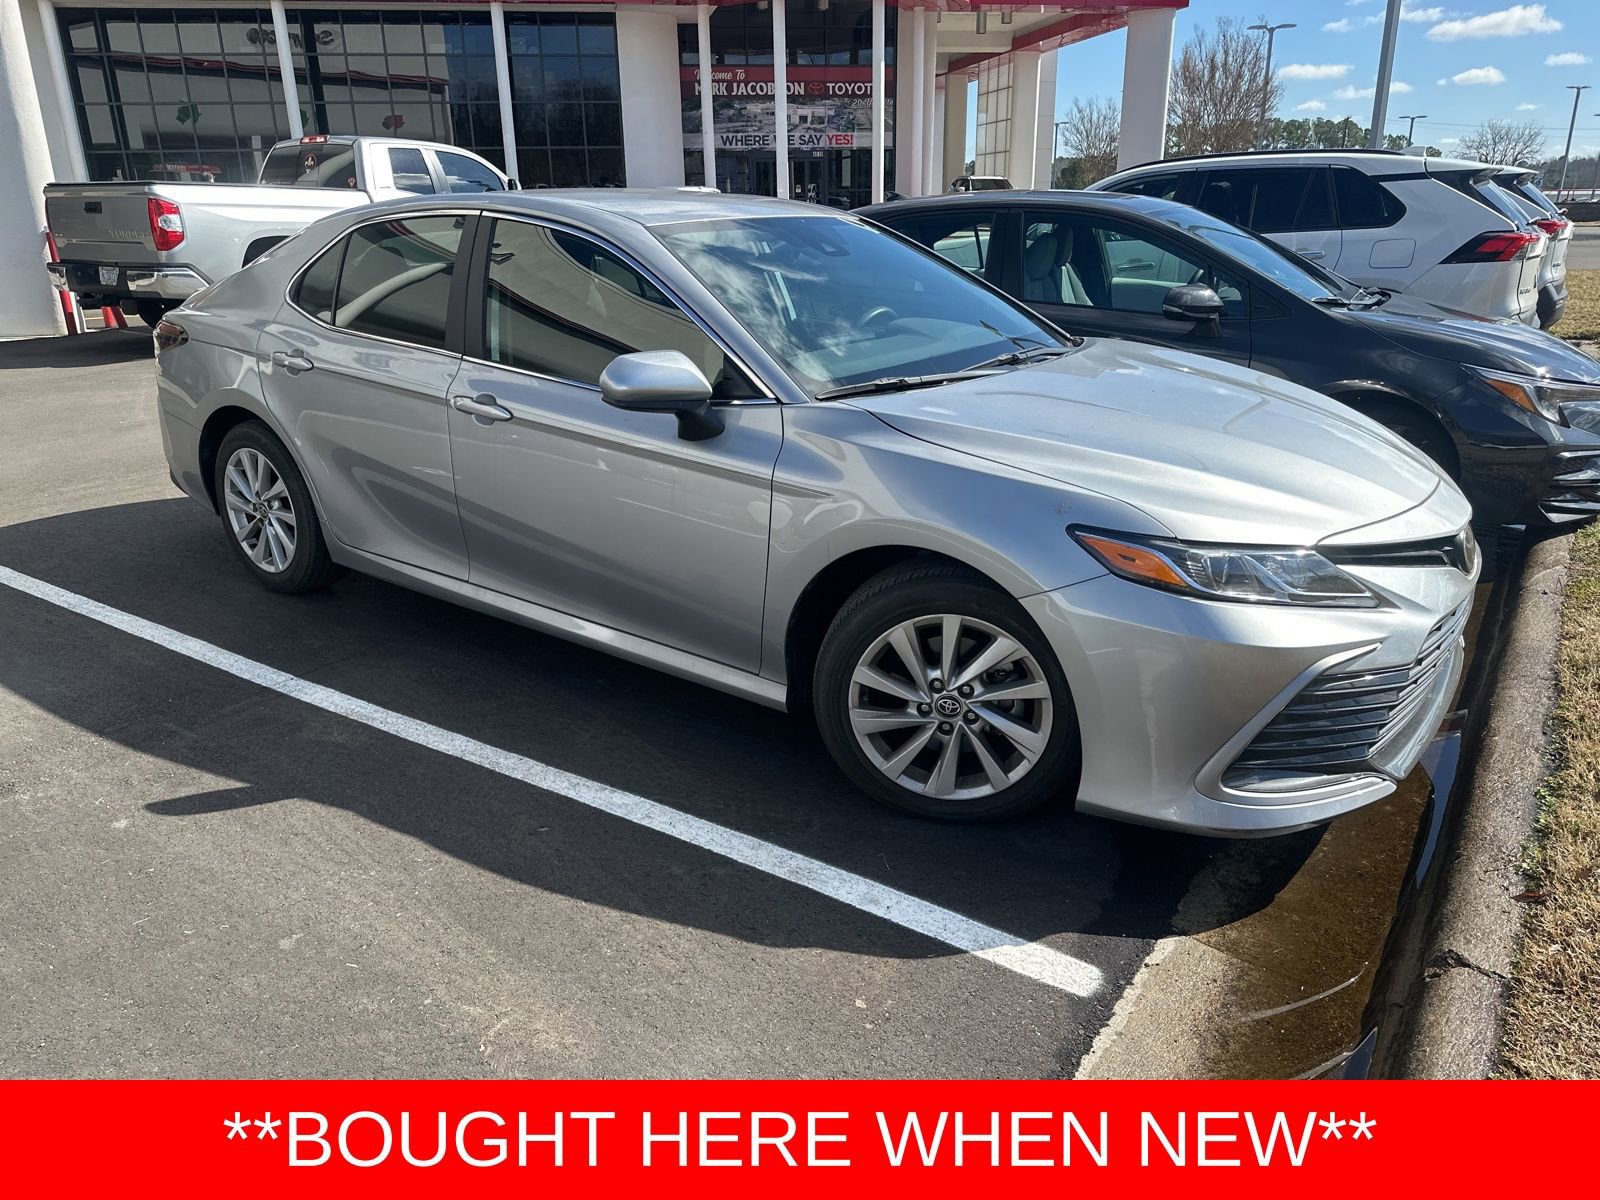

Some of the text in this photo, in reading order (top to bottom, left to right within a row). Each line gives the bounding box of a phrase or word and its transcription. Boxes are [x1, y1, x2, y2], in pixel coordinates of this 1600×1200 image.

[735, 69, 746, 81] To
[694, 82, 805, 96] MRK JACOBON
[826, 82, 873, 95] TOYOT
[720, 134, 854, 146] WHERE E SAY YES!
